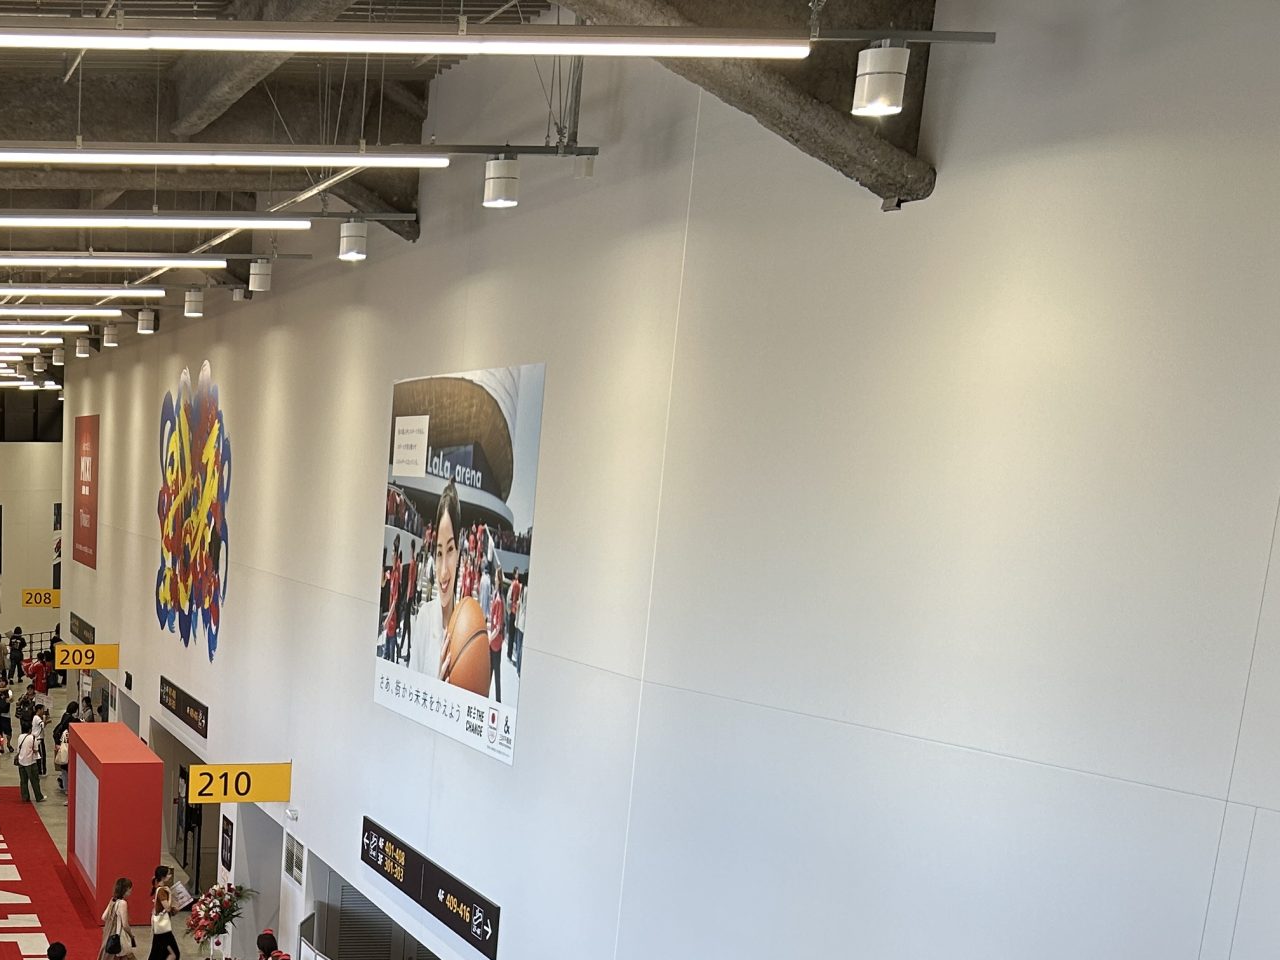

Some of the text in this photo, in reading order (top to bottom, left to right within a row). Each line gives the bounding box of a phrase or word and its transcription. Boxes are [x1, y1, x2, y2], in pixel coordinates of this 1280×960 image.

[427, 446, 451, 479] LaLa
[455, 464, 482, 488] arena
[25, 592, 52, 605] 208
[60, 648, 95, 667] 209
[197, 770, 252, 797] 210
[437, 888, 470, 923] 4F 409-416
